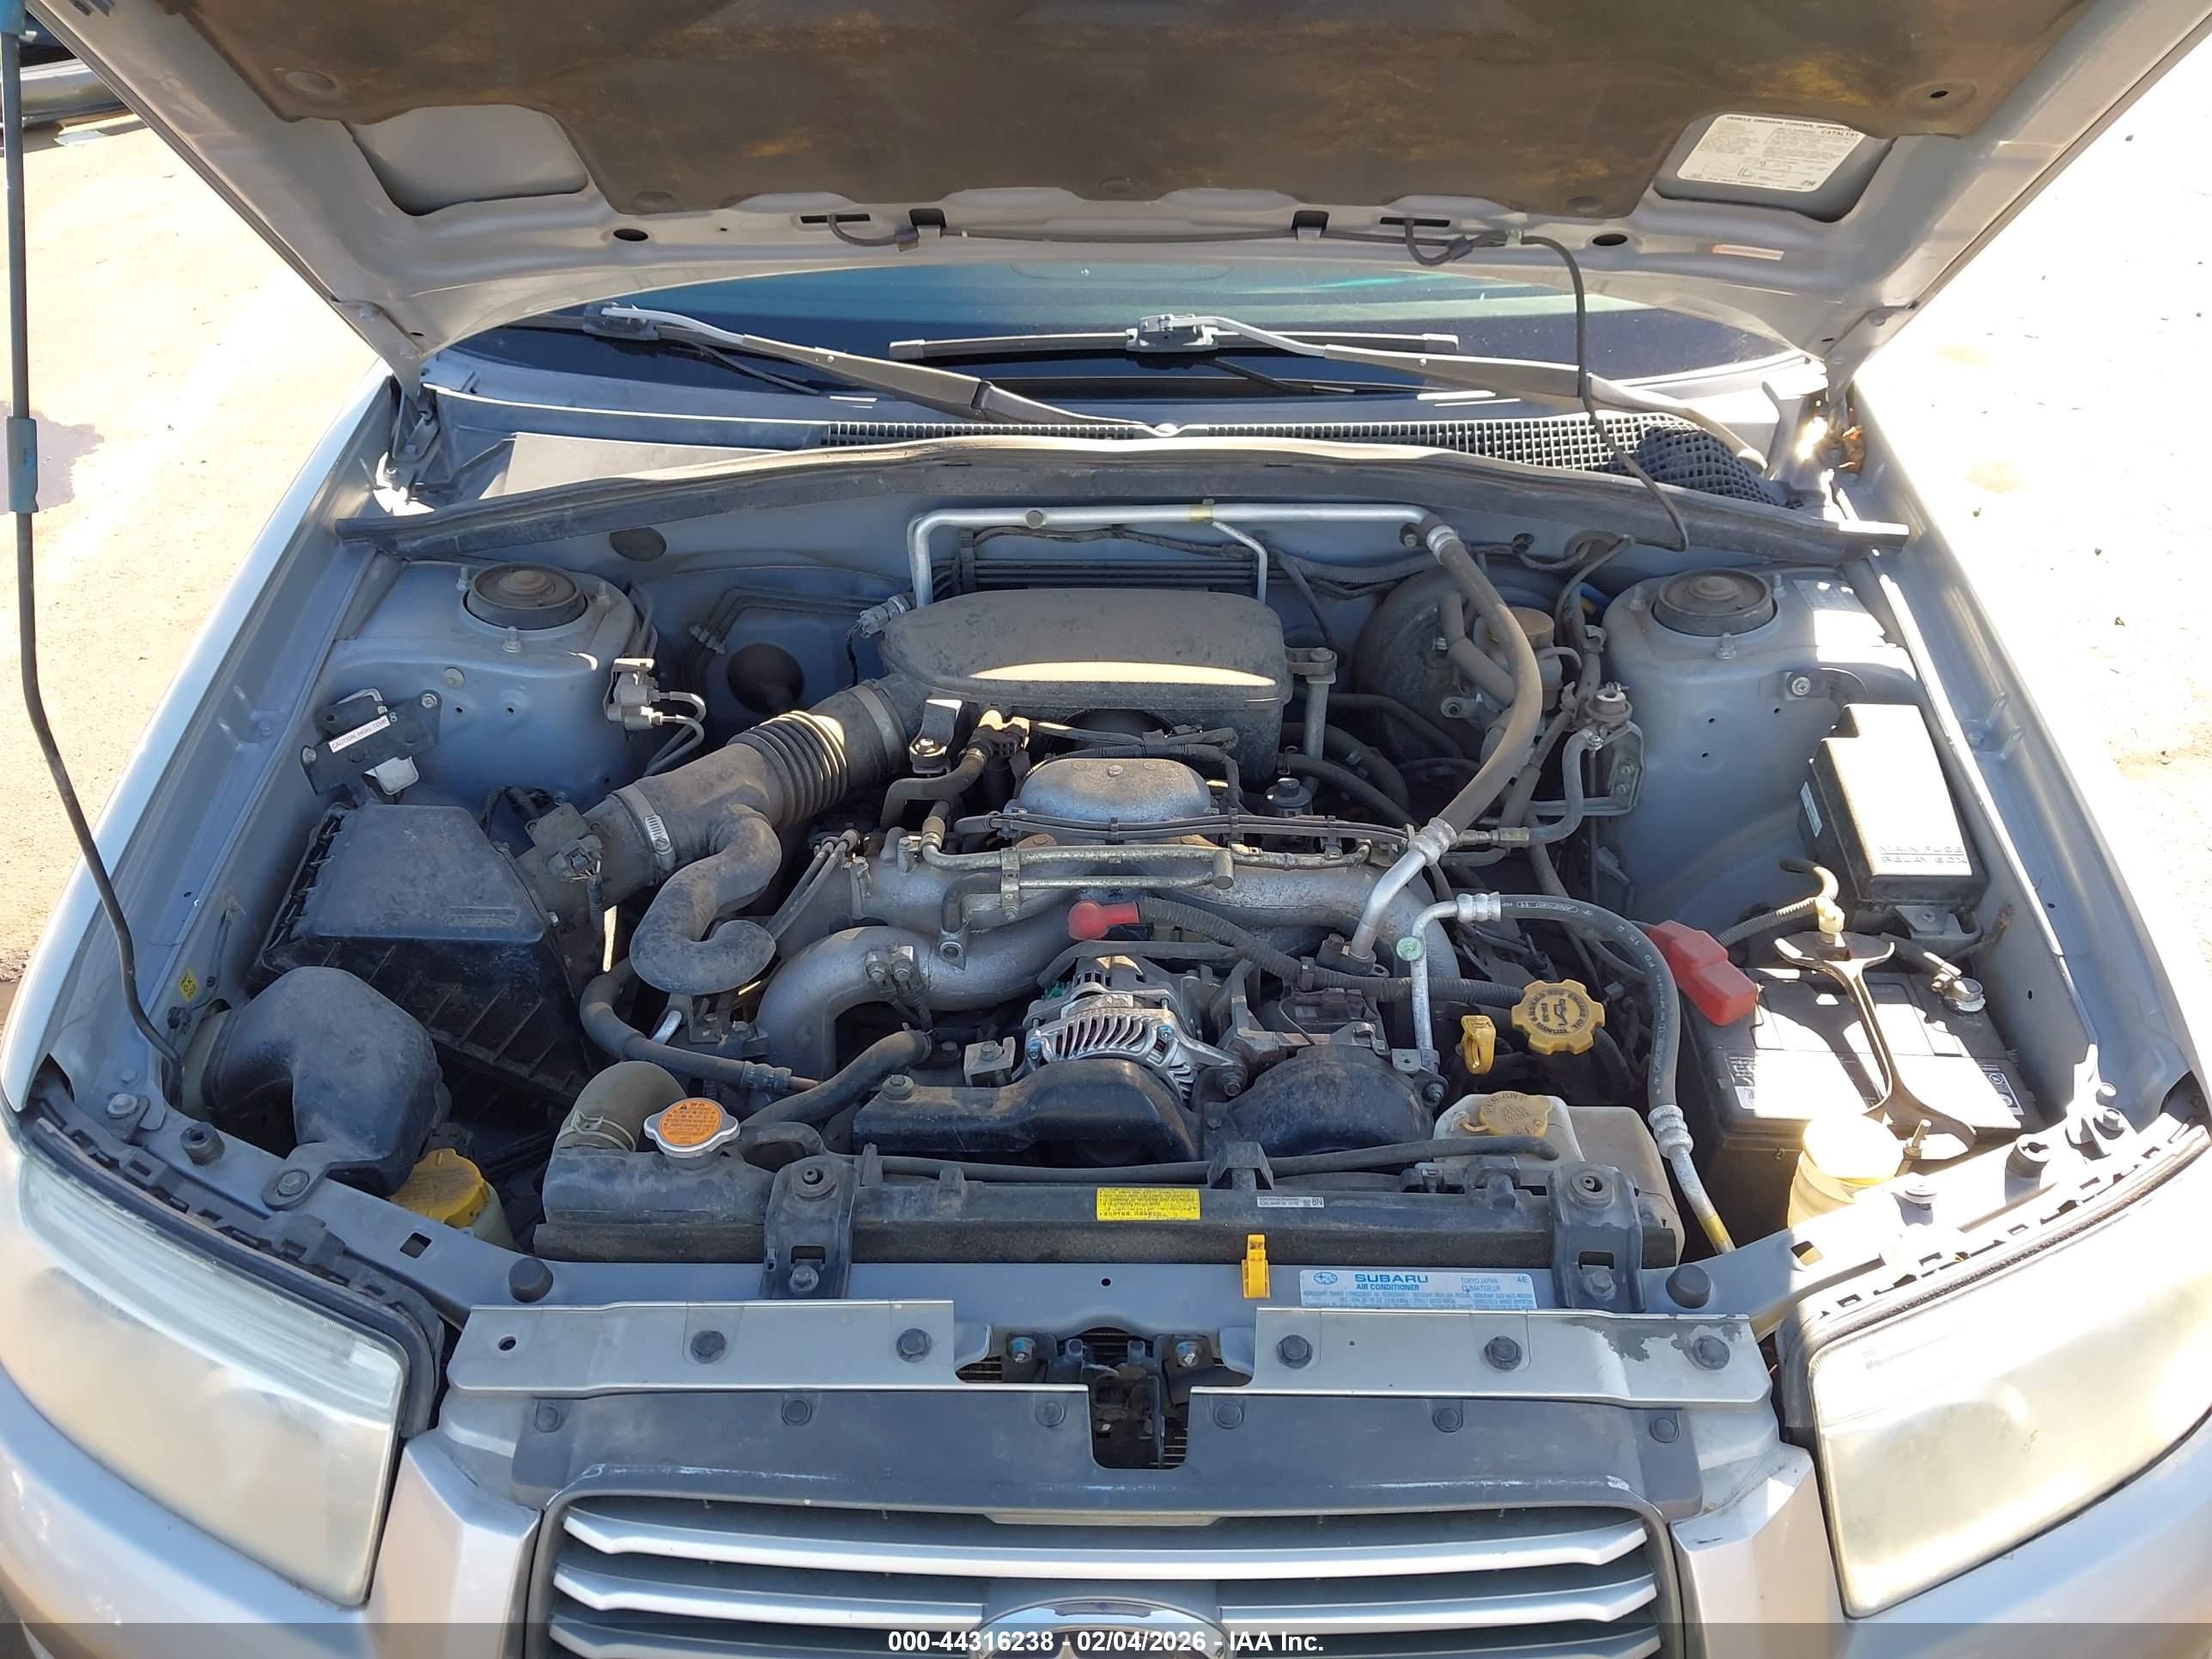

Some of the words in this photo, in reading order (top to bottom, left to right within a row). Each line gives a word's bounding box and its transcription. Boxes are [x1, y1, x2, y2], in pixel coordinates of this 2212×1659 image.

[389, 712, 398, 722] 8
[331, 734, 356, 749] CAUTION
[356, 726, 371, 737] HIGH
[372, 719, 386, 730] TEMP
[1567, 993, 1587, 1019] ENGINE
[1535, 1021, 1571, 1035] MANUAL
[1571, 1018, 1584, 1030] OIL
[1354, 1273, 1429, 1284] SUBARU
